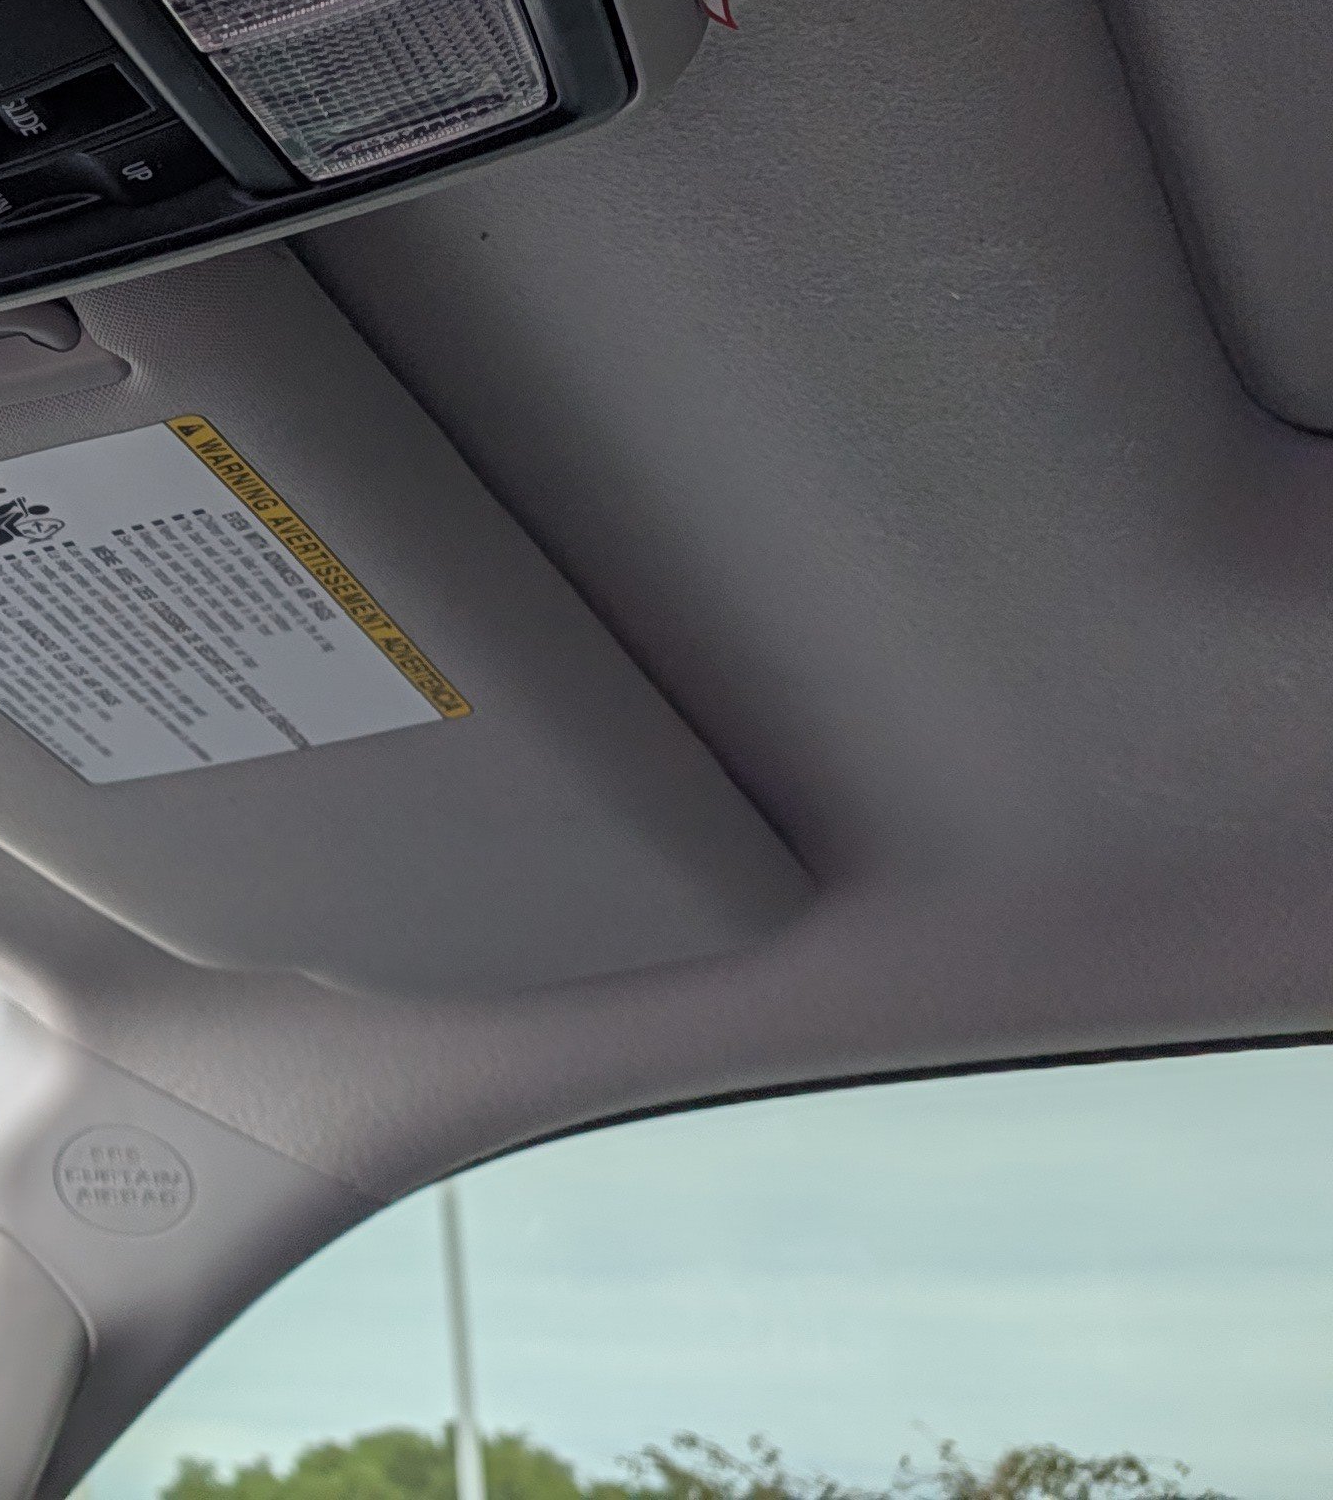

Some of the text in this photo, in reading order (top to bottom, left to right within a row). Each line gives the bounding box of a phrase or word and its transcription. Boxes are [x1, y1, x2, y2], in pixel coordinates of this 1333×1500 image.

[1, 97, 48, 139] SLIDE
[121, 159, 154, 184] UP
[196, 437, 279, 512] WARNING
[268, 515, 393, 631] AVERTISSEMENT
